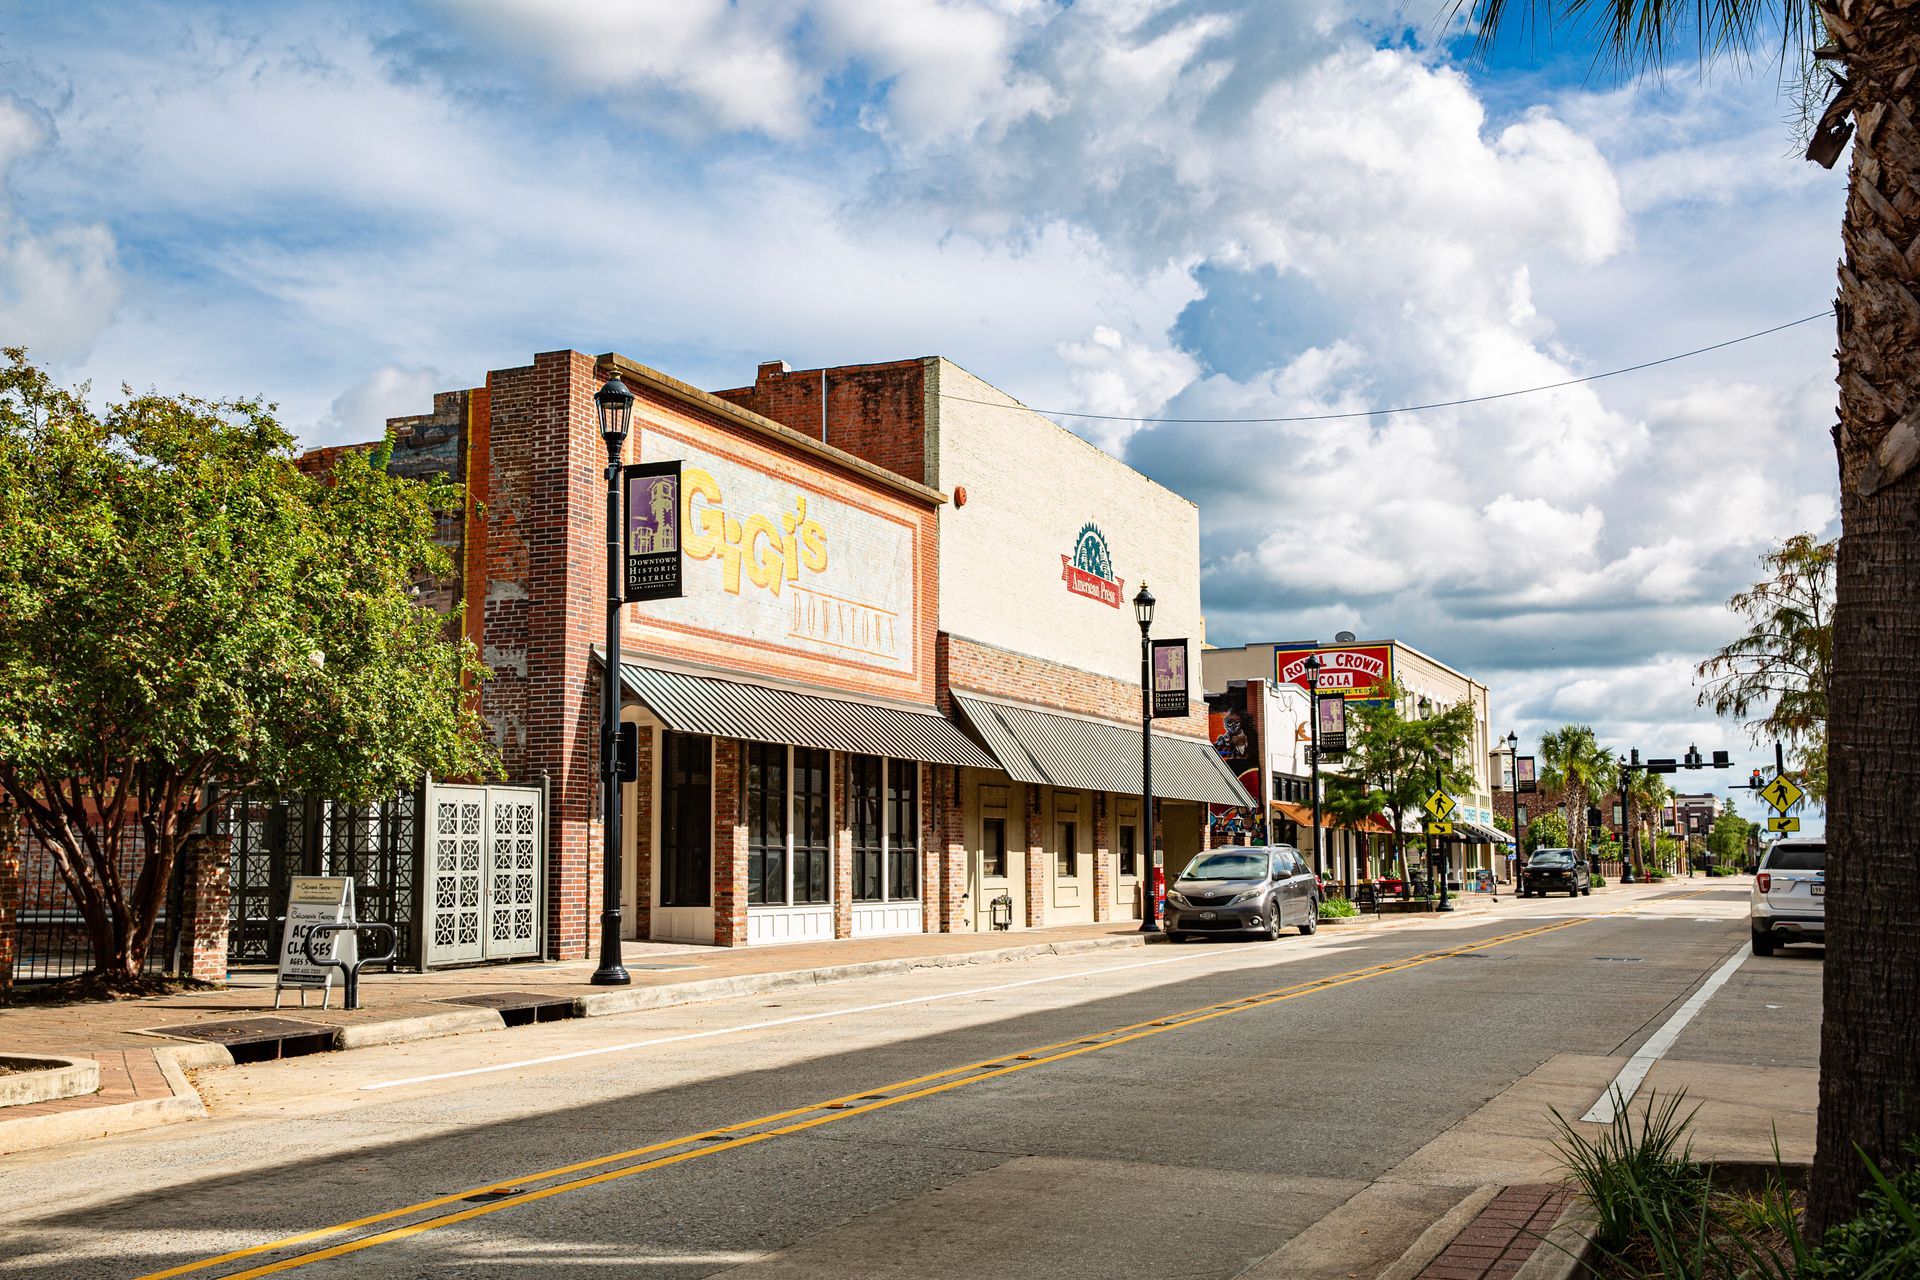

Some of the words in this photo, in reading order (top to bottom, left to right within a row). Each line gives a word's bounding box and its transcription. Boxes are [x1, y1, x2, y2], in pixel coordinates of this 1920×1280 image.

[1072, 572, 1100, 597] American
[1101, 581, 1116, 603] Press
[1285, 656, 1327, 678] ROL
[1336, 654, 1382, 674] CROWN
[1319, 674, 1350, 686] COLA
[287, 941, 332, 956] CLASES
